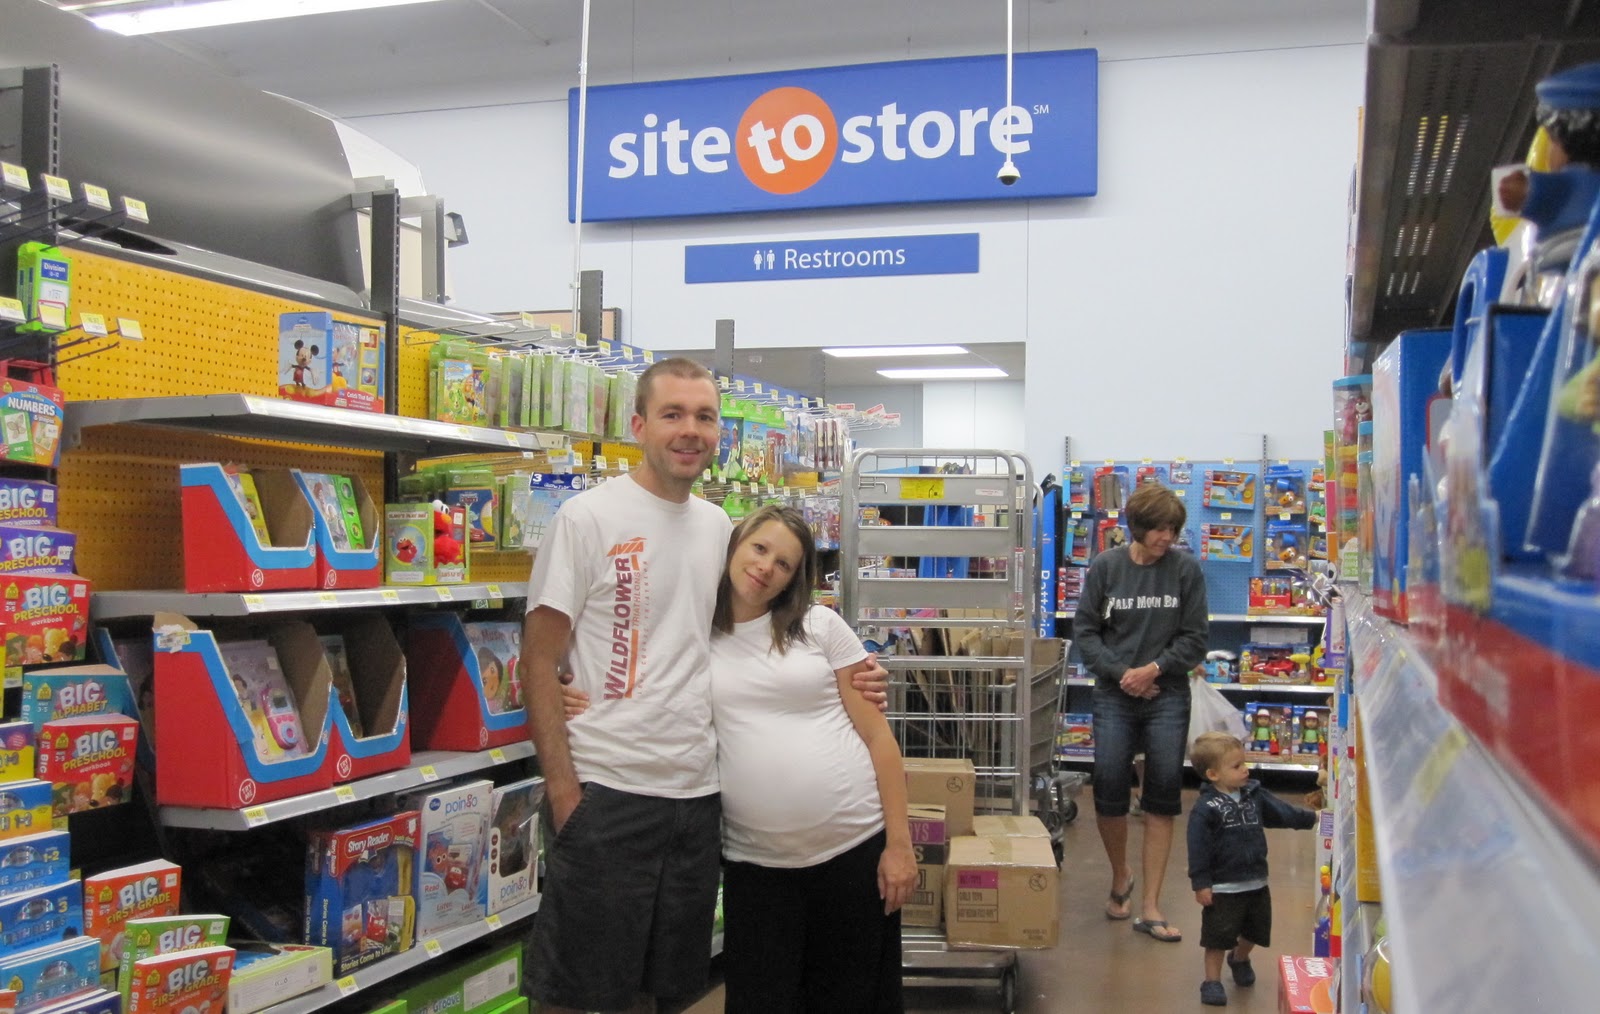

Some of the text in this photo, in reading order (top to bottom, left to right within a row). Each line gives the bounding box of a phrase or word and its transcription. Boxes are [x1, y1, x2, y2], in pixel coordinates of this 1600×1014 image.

[1033, 104, 1050, 115] SM
[608, 103, 1034, 179] site to store
[43, 262, 66, 273] Division
[784, 248, 907, 270] Restrooms
[8, 396, 56, 417] NUMBERS
[532, 474, 543, 482] 3
[0, 487, 36, 510] BIG
[10, 536, 52, 561] BIG
[25, 584, 68, 609] BIG
[632, 571, 641, 628] TRIATHLONS
[13, 603, 79, 623] PRESCHOOL
[31, 617, 63, 626] workbook
[604, 557, 633, 700] WILDFLOWER
[60, 682, 100, 710] BIG
[52, 700, 108, 720] ALPHABET
[75, 729, 116, 756] BIG
[40, 754, 49, 774] BIG
[62, 747, 127, 772] PRESCHOOL
[348, 840, 367, 854] Story
[367, 832, 390, 848] Reader
[43, 850, 60, 862] 1-2
[120, 877, 158, 909] BIG
[424, 883, 440, 893] Read
[58, 901, 69, 913] 3
[107, 904, 136, 926] FIRST
[138, 892, 171, 911] GRADE
[85, 909, 94, 929] BIG
[159, 924, 201, 954] BIG
[341, 959, 359, 972] Stories
[360, 952, 375, 965] Come
[168, 959, 208, 993] BIG
[130, 991, 140, 1012] BIG
[152, 974, 220, 1009] FIRST GRADE
[433, 991, 460, 1013] Groove
